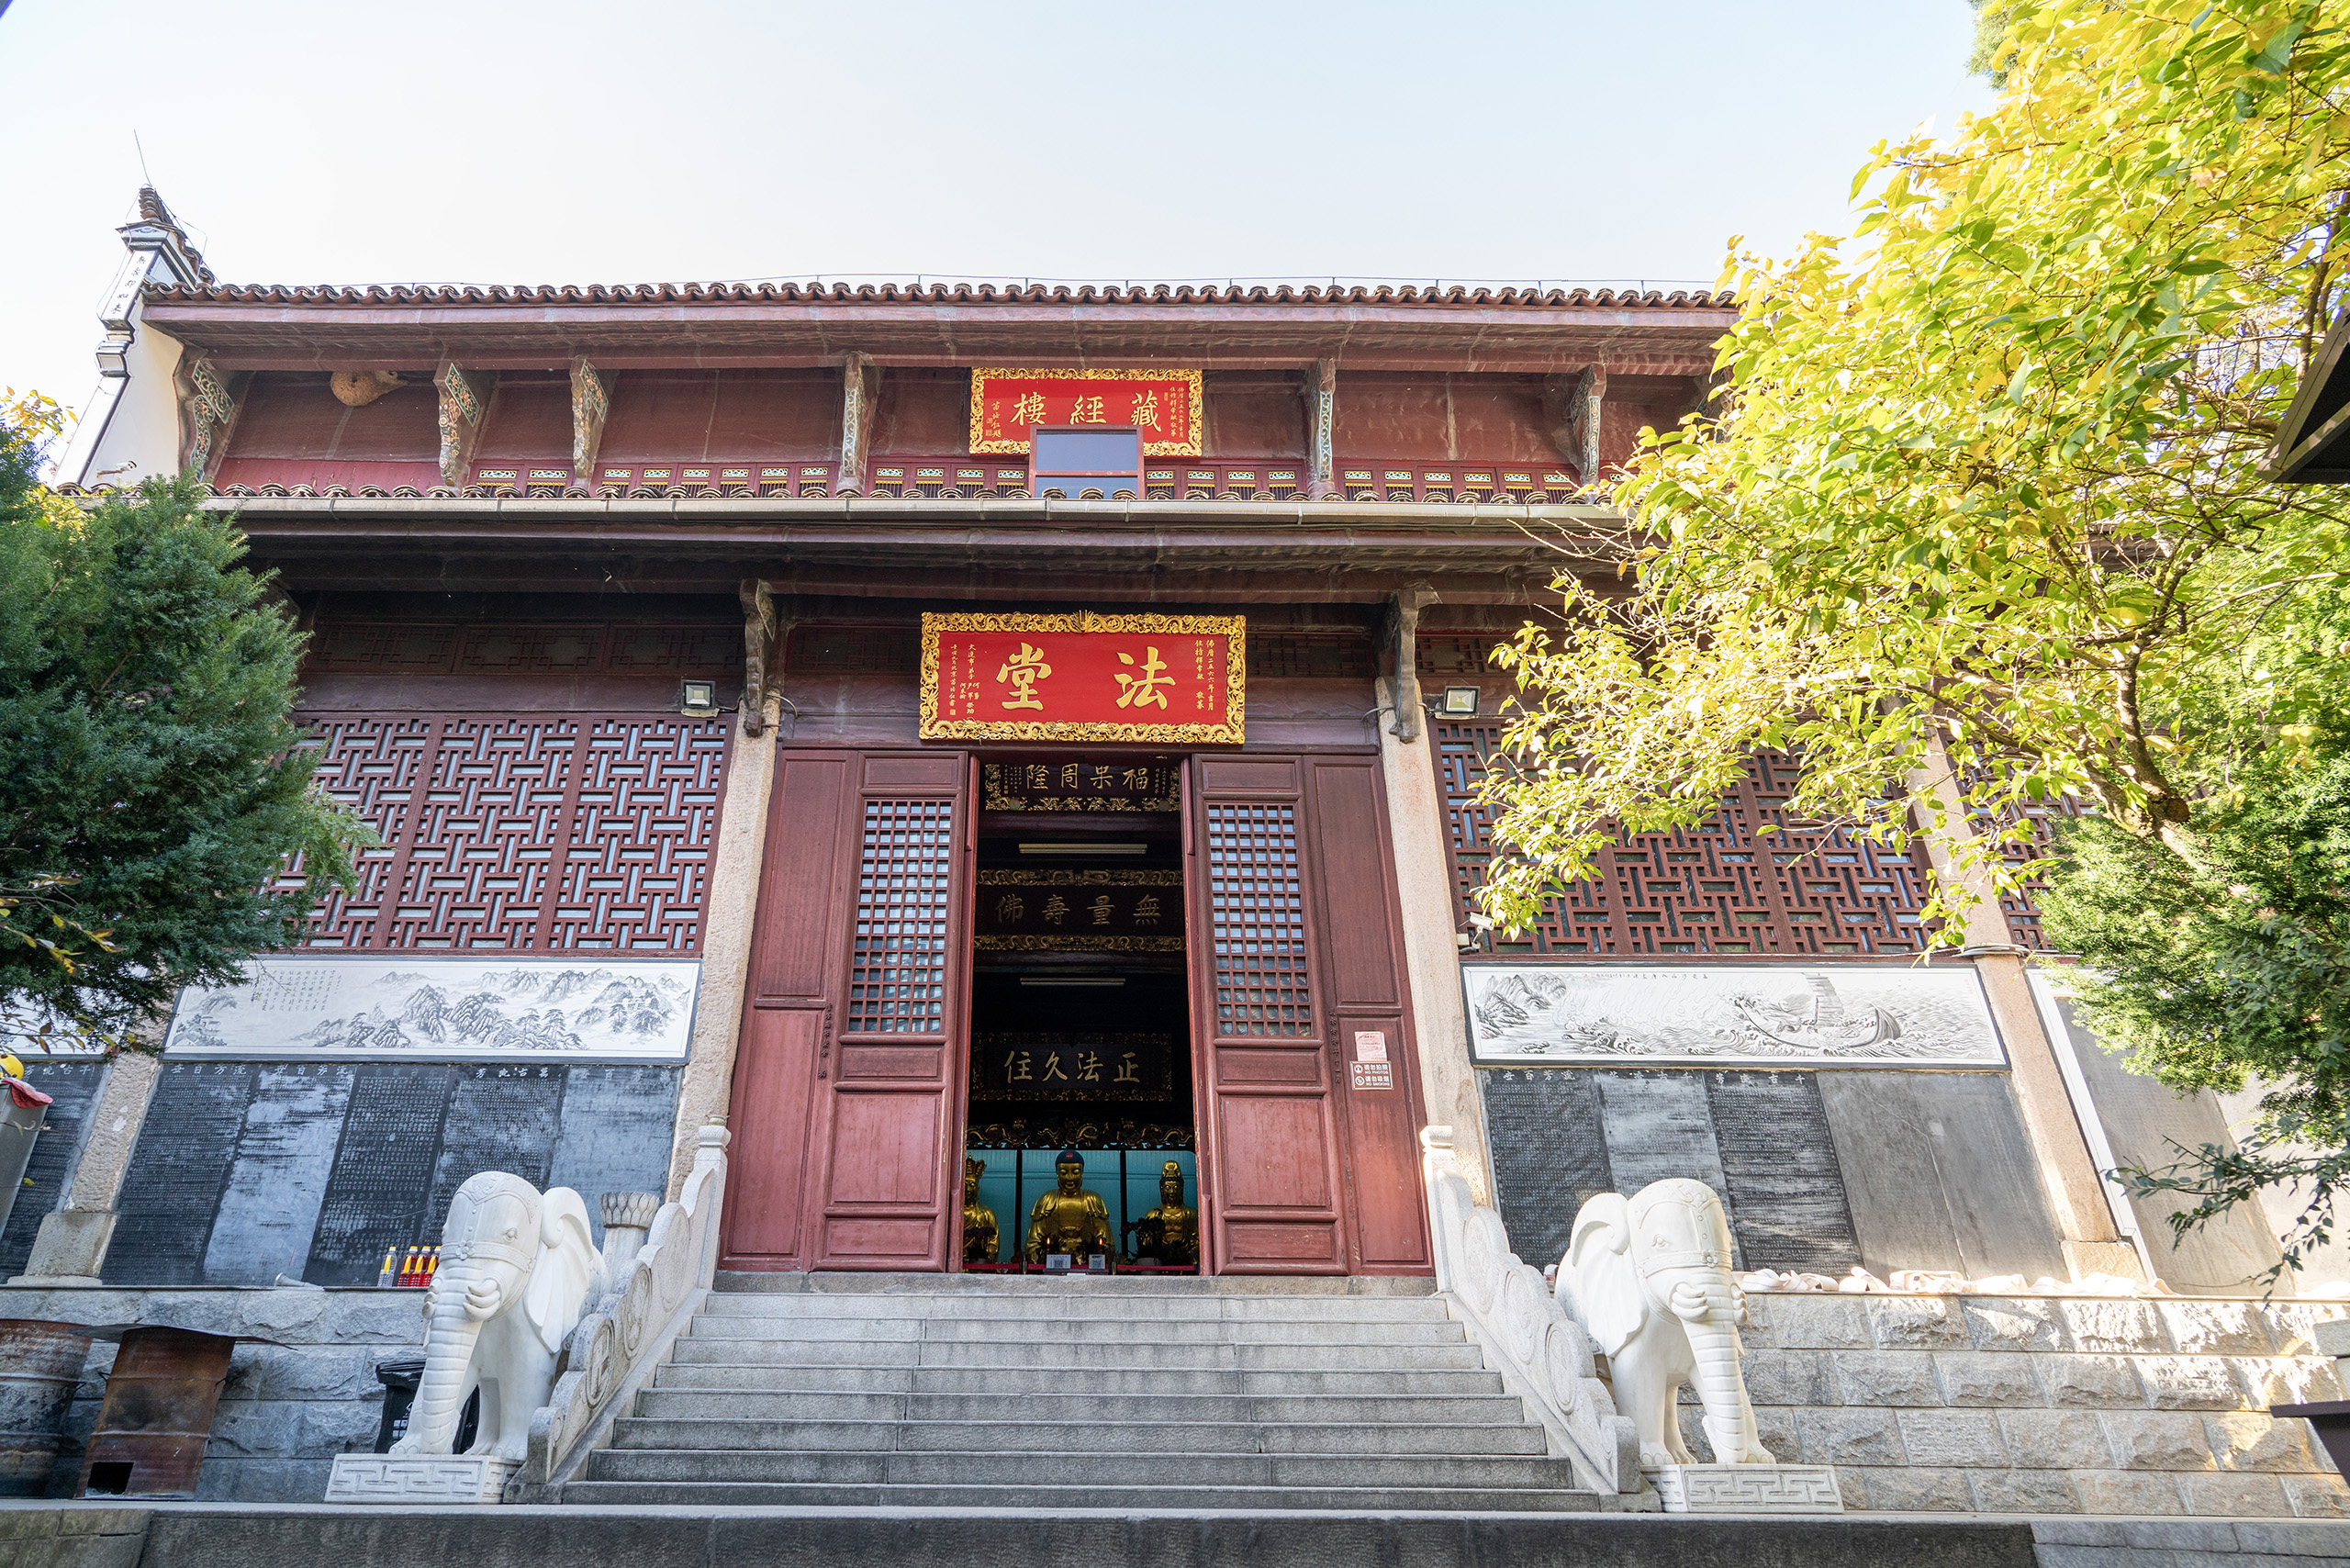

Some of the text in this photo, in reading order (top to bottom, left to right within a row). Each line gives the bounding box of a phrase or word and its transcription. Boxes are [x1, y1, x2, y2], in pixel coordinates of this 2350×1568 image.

[1010, 389, 1162, 432] 藏經樓
[995, 642, 1177, 711] 法堂
[1025, 763, 1150, 790] 福果周隆
[994, 893, 1162, 926] 無量壽佛
[1003, 1050, 1141, 1083] 正法久住
